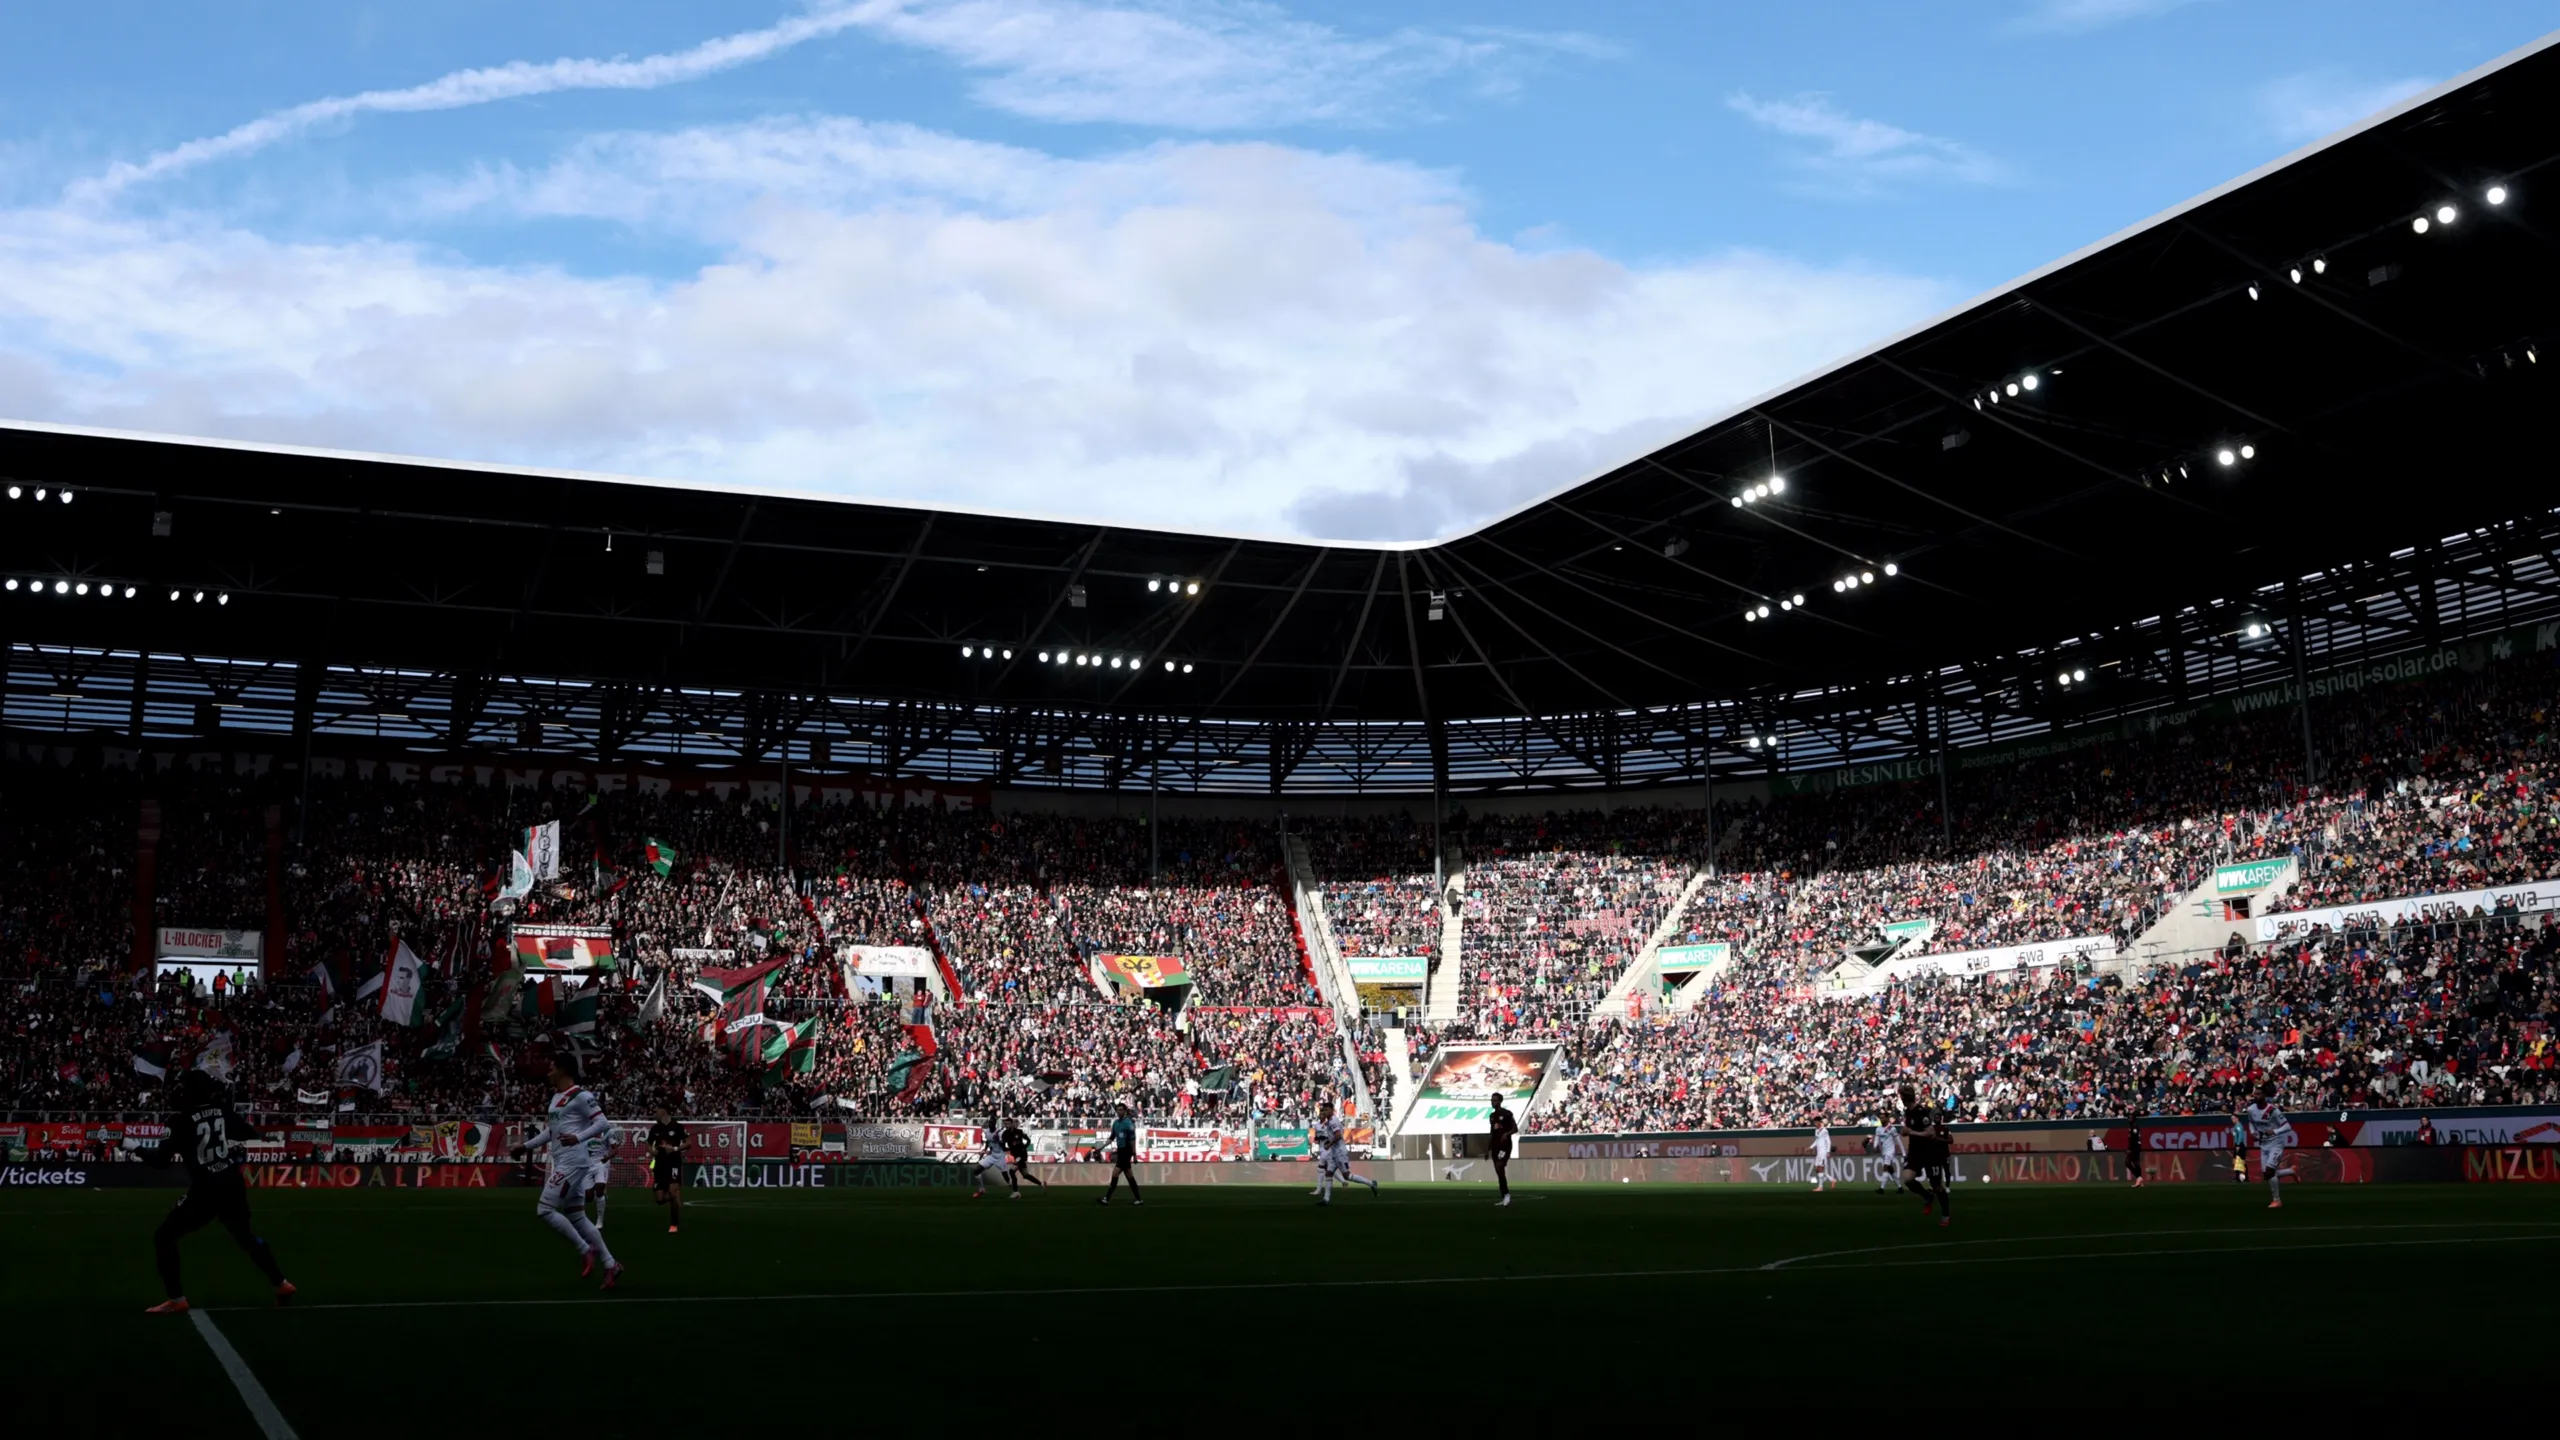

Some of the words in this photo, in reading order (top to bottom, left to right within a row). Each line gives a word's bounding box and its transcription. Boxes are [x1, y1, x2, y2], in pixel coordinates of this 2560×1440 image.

[1836, 756, 1941, 787] RESINTECH
[2500, 891, 2537, 908] swa
[2347, 909, 2380, 925] swa
[2421, 901, 2456, 917] swa
[2277, 918, 2308, 934] swa
[2339, 1112, 2348, 1122] 8
[125, 1125, 166, 1136] SCHWA
[197, 1117, 229, 1165] 23
[0, 1166, 87, 1186] /tickets
[241, 1165, 361, 1187] MIZUNO
[367, 1165, 486, 1188] ALPHA
[693, 1164, 825, 1188] ABSOLUTE
[1032, 1165, 1112, 1185] IZUNO
[1989, 1156, 2081, 1182] MIZUNO
[2087, 1154, 2193, 1182] ALHA
[549, 1171, 565, 1187] 32
